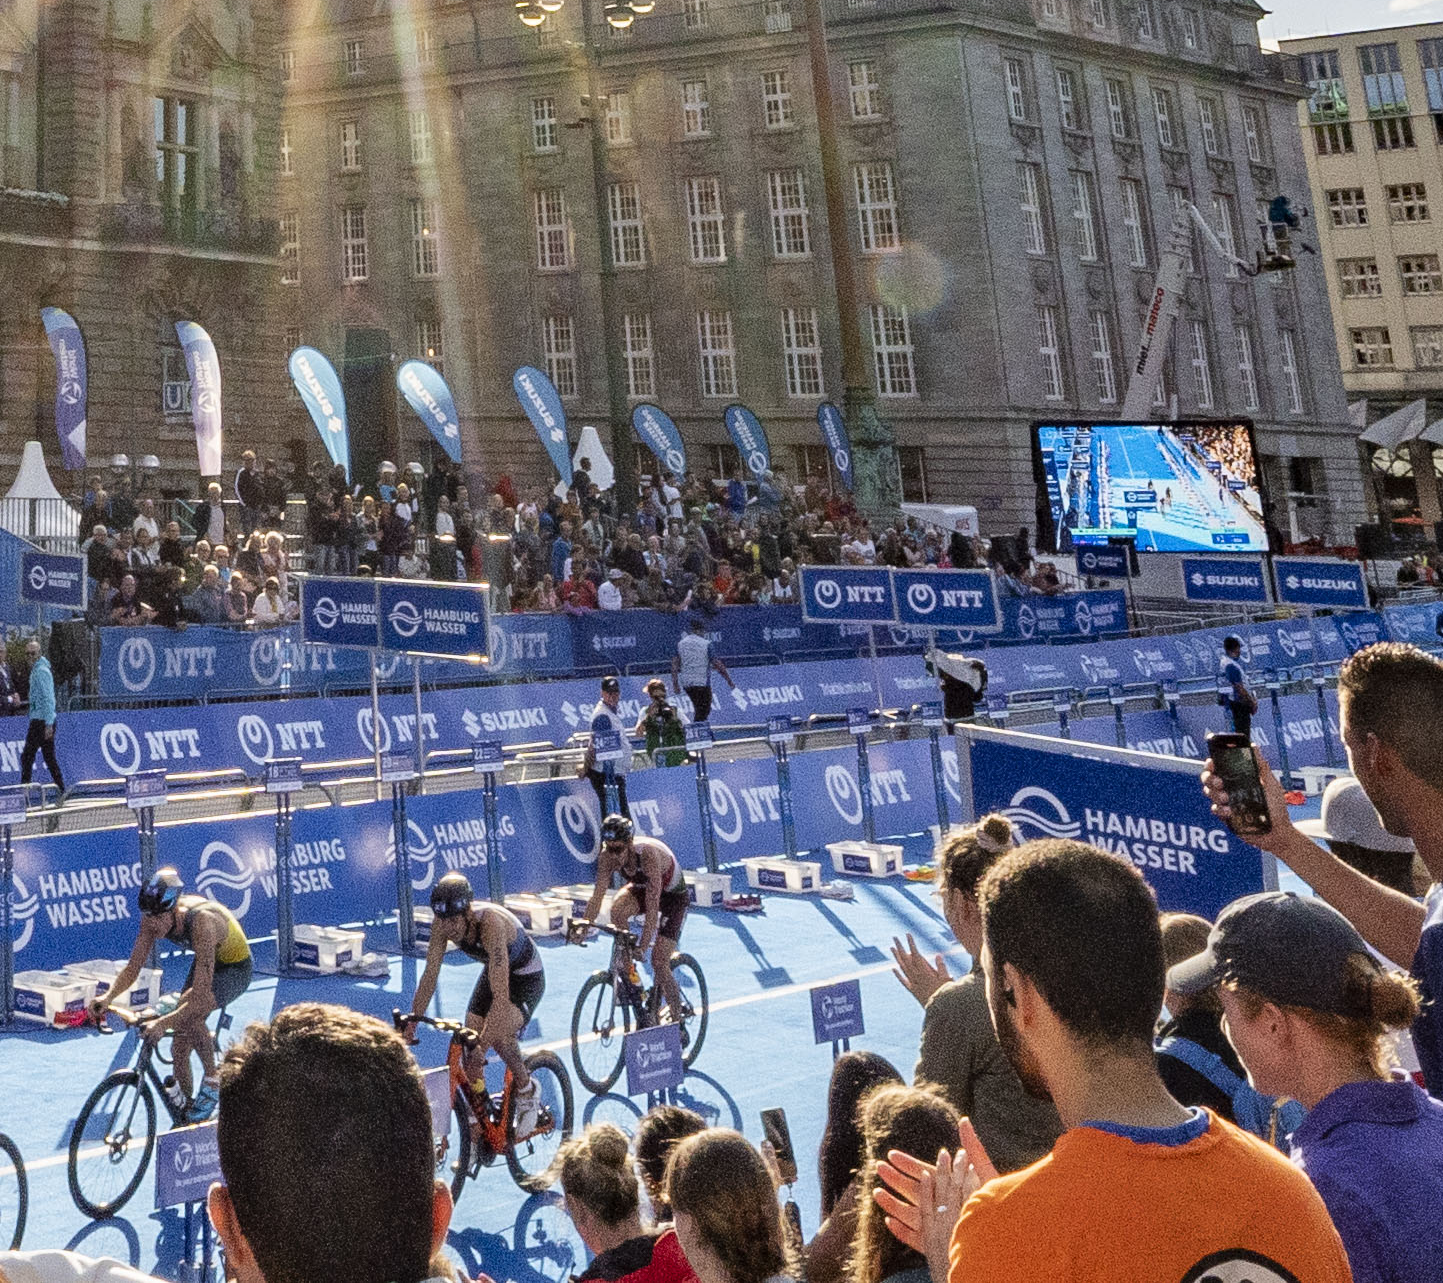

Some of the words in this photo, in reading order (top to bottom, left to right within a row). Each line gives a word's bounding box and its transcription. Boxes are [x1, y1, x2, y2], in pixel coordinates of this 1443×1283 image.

[1206, 575, 1259, 586] SUZUKI
[1301, 577, 1357, 591] SUZUKI
[846, 585, 885, 603] NTT
[941, 589, 984, 609] NTT
[424, 608, 480, 624] HAMBURG
[425, 619, 467, 635] WASSER
[512, 633, 548, 660] NTT
[164, 647, 216, 677] NTT
[747, 685, 804, 707] SUZUKI
[480, 707, 548, 733] SUZUKI
[144, 729, 200, 762] NTT
[276, 719, 325, 751] NTT
[1084, 807, 1230, 853] HAMBURG
[39, 863, 142, 899] HAMBURG
[45, 894, 130, 930] WASSER
